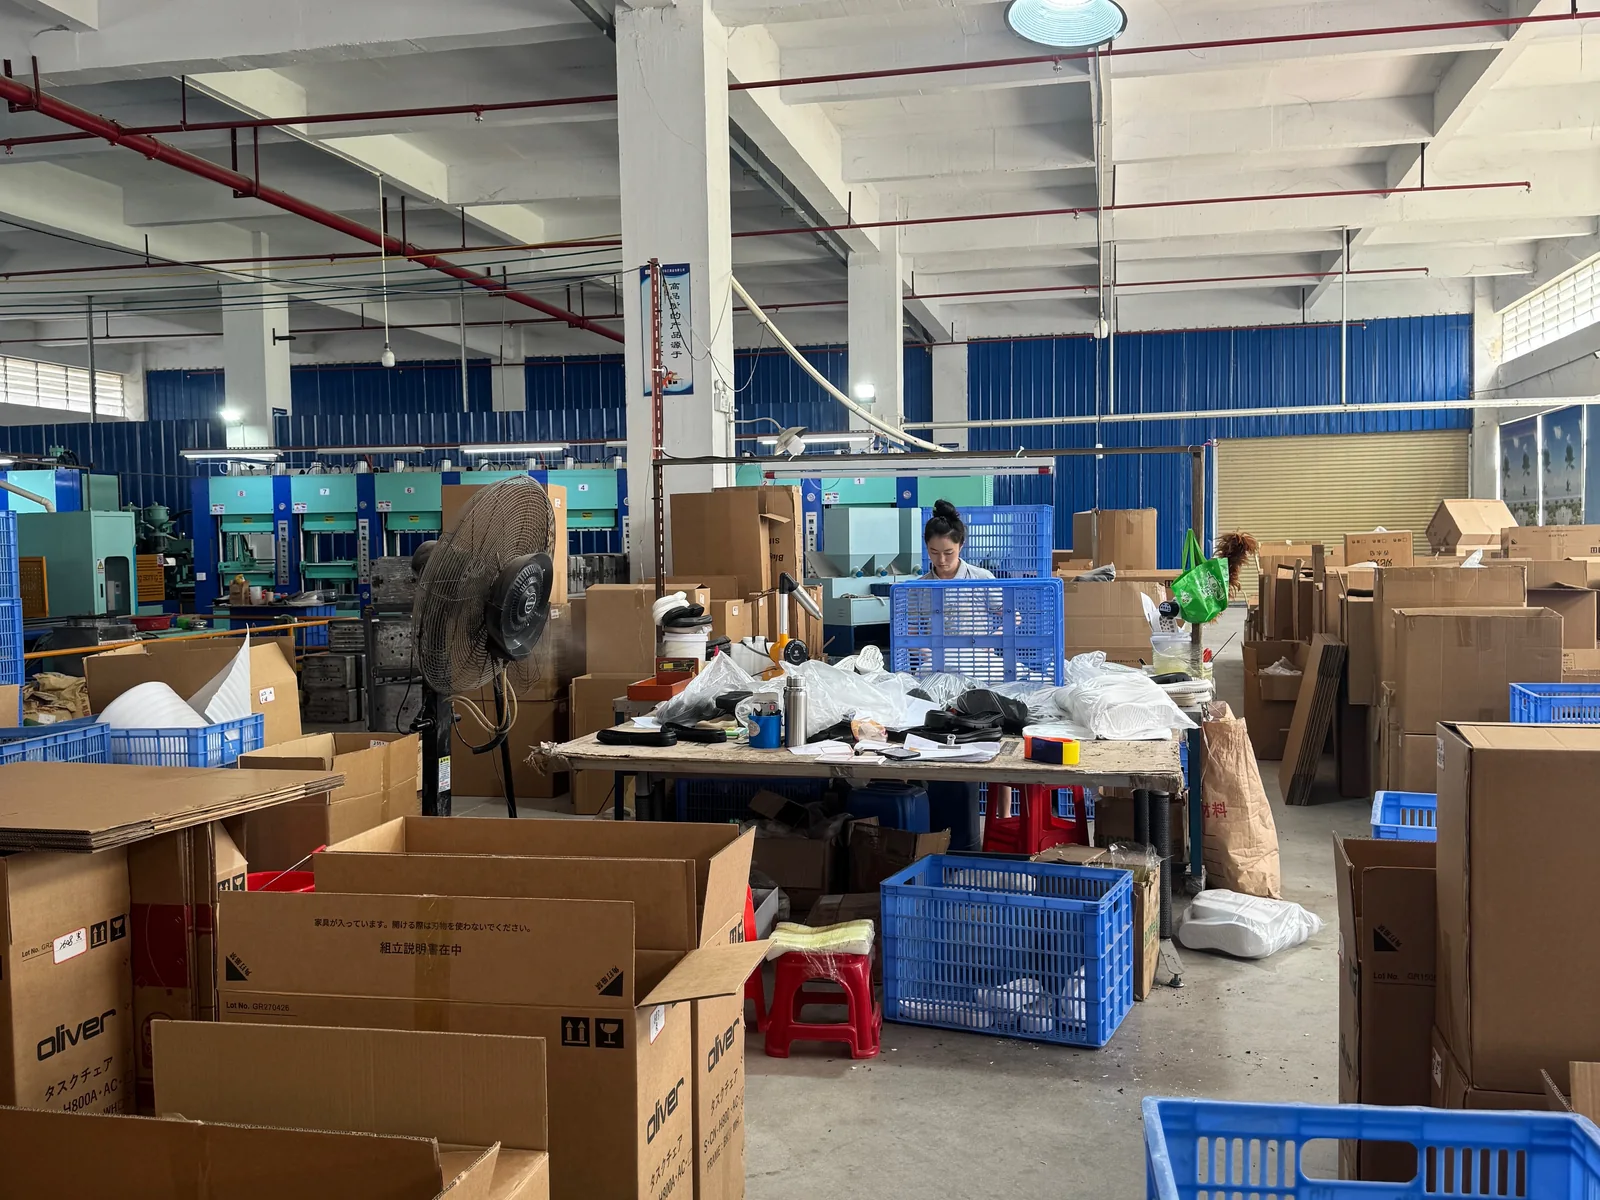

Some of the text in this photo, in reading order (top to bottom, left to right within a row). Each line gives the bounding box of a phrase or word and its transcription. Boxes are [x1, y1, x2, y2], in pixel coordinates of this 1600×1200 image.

[380, 941, 462, 956] 組立説明書在中
[1373, 971, 1386, 980] Lot
[226, 1002, 290, 1012] Lot No. GR270426
[37, 1008, 116, 1061] oliver
[708, 1017, 740, 1073] oliver
[45, 1056, 113, 1102] タスクチェア
[710, 1067, 738, 1117] タスクチェア
[646, 1077, 684, 1145] oliver
[650, 1133, 683, 1194] タスクチェア
